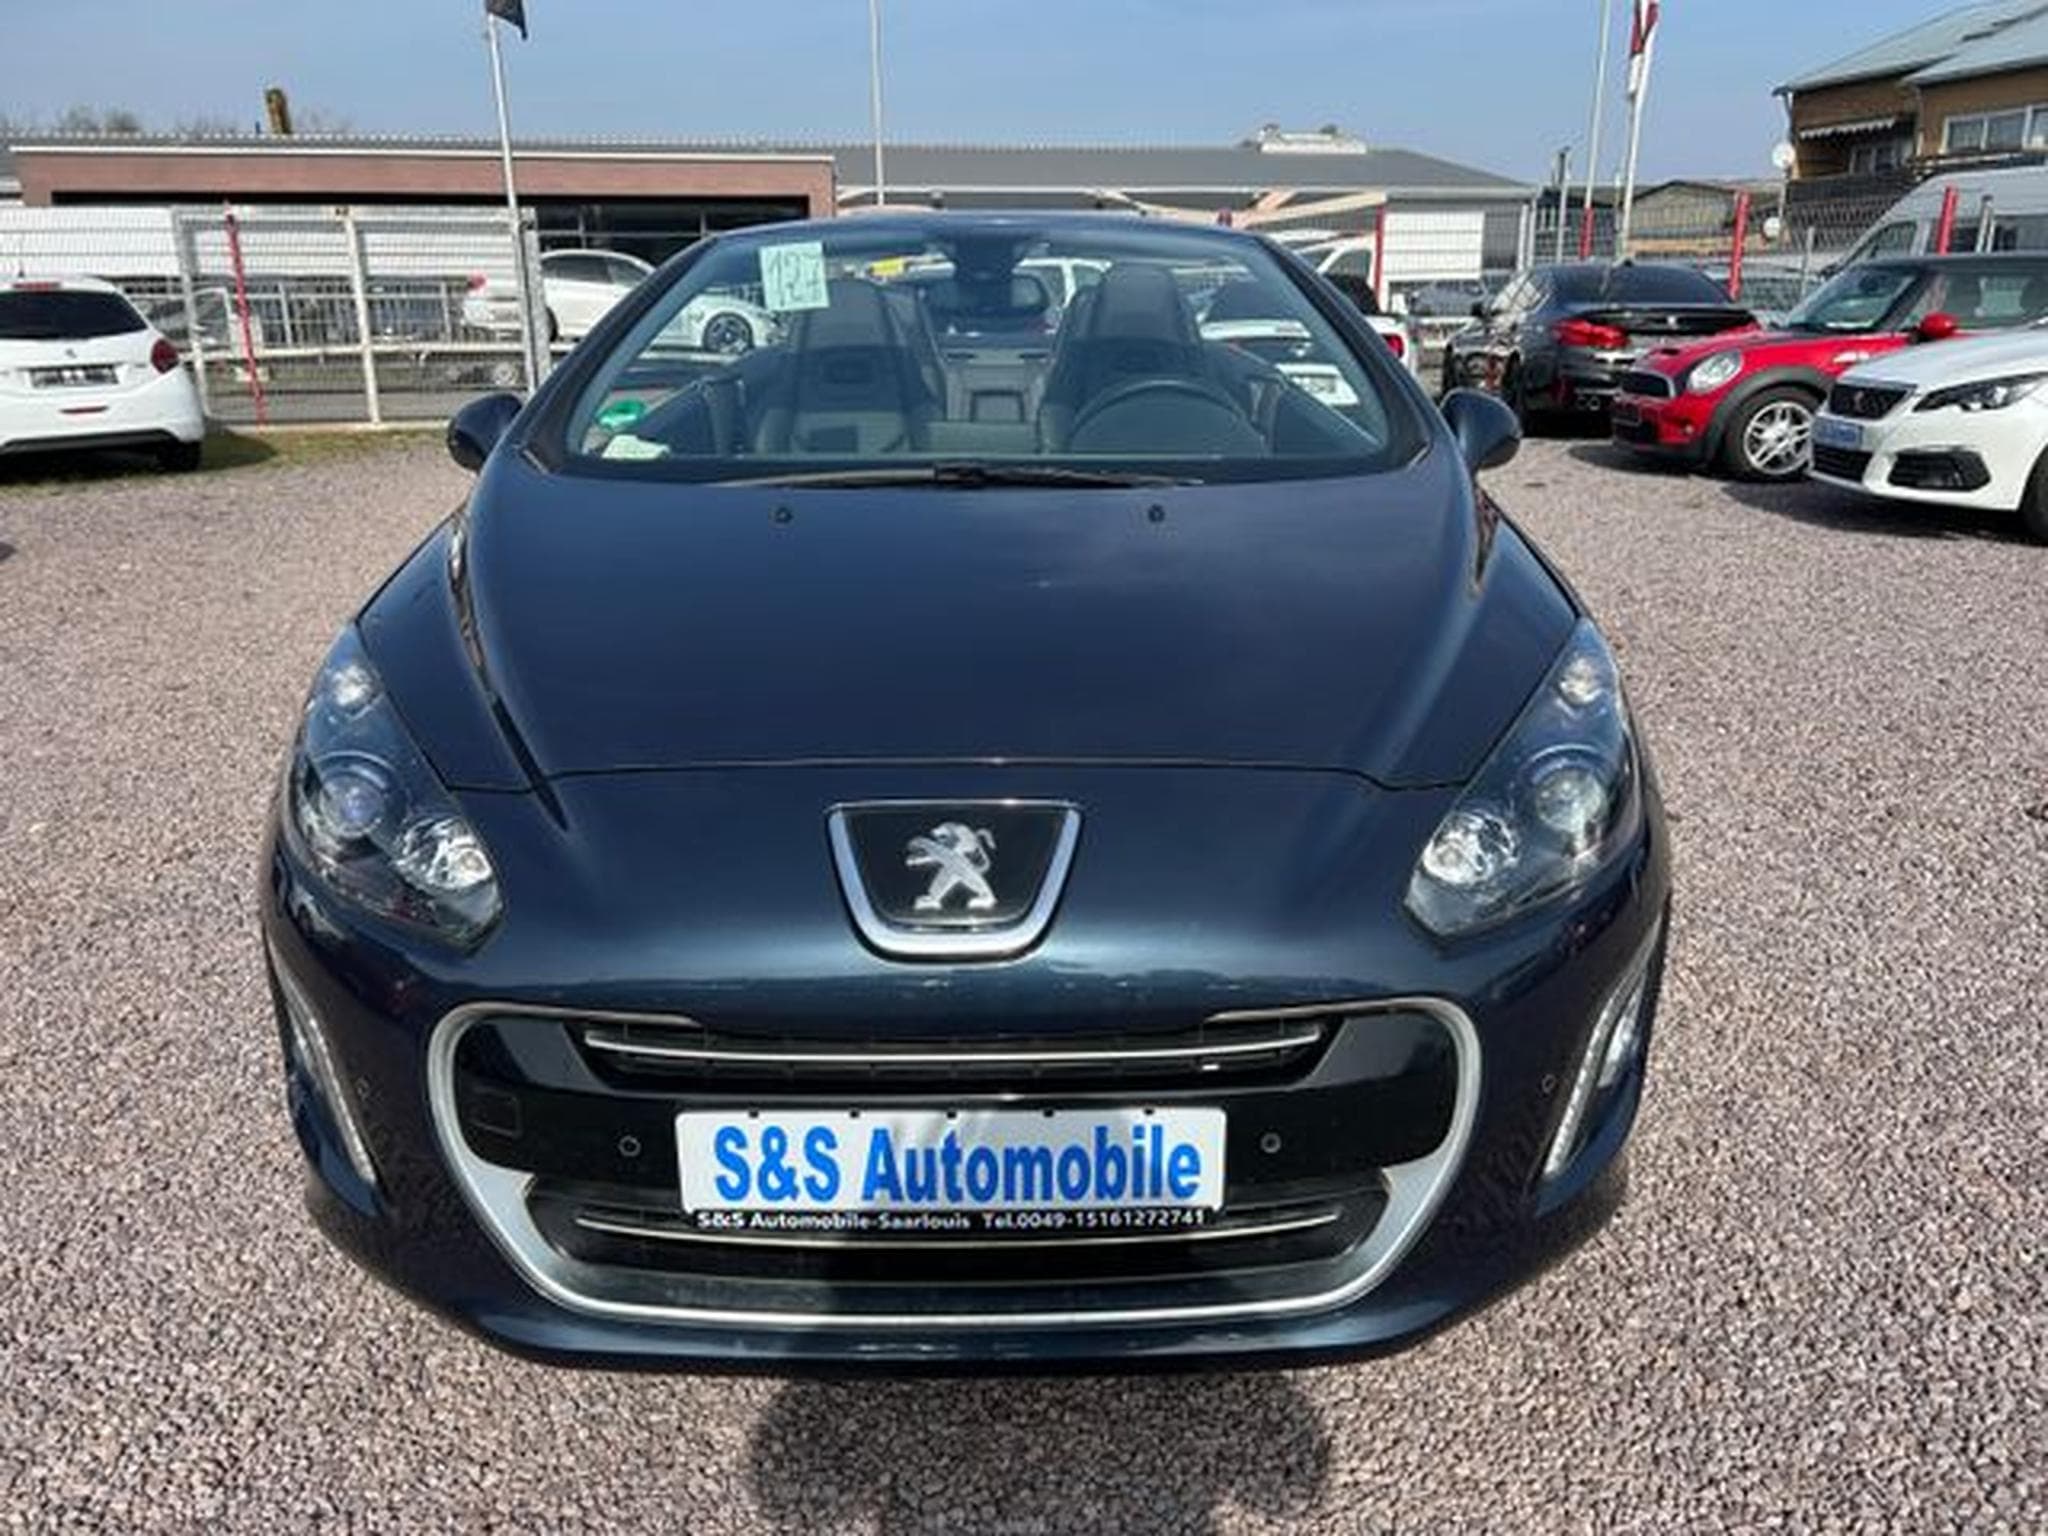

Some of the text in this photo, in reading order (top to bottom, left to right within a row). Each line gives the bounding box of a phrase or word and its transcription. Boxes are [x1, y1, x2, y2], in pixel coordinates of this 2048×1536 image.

[713, 1123, 1201, 1202] S&S Automobile
[697, 1212, 745, 1228] S&S
[750, 1211, 971, 1230] Automobile-Saarlouis
